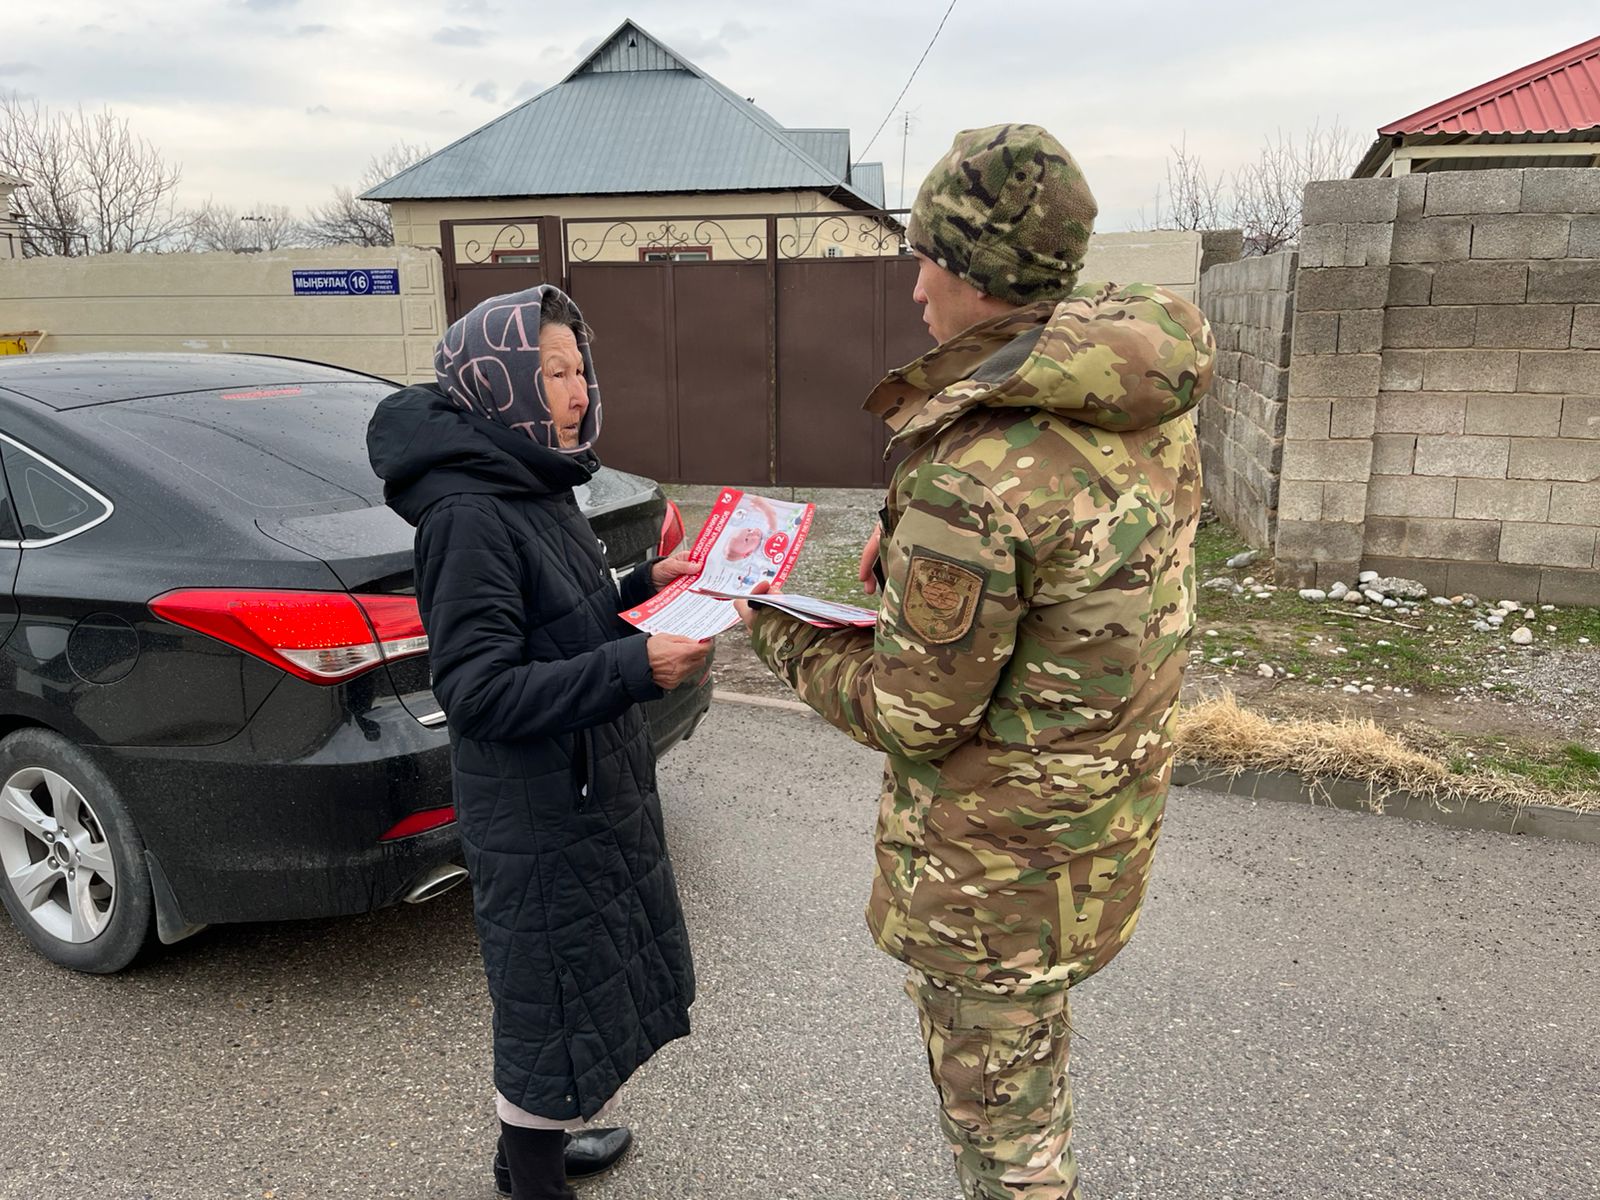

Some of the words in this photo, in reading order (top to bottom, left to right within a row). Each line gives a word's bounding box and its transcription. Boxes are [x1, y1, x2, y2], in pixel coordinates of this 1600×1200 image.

[352, 276, 366, 289] 16
[769, 534, 785, 555] 112
[787, 554, 796, 564] НЕ
